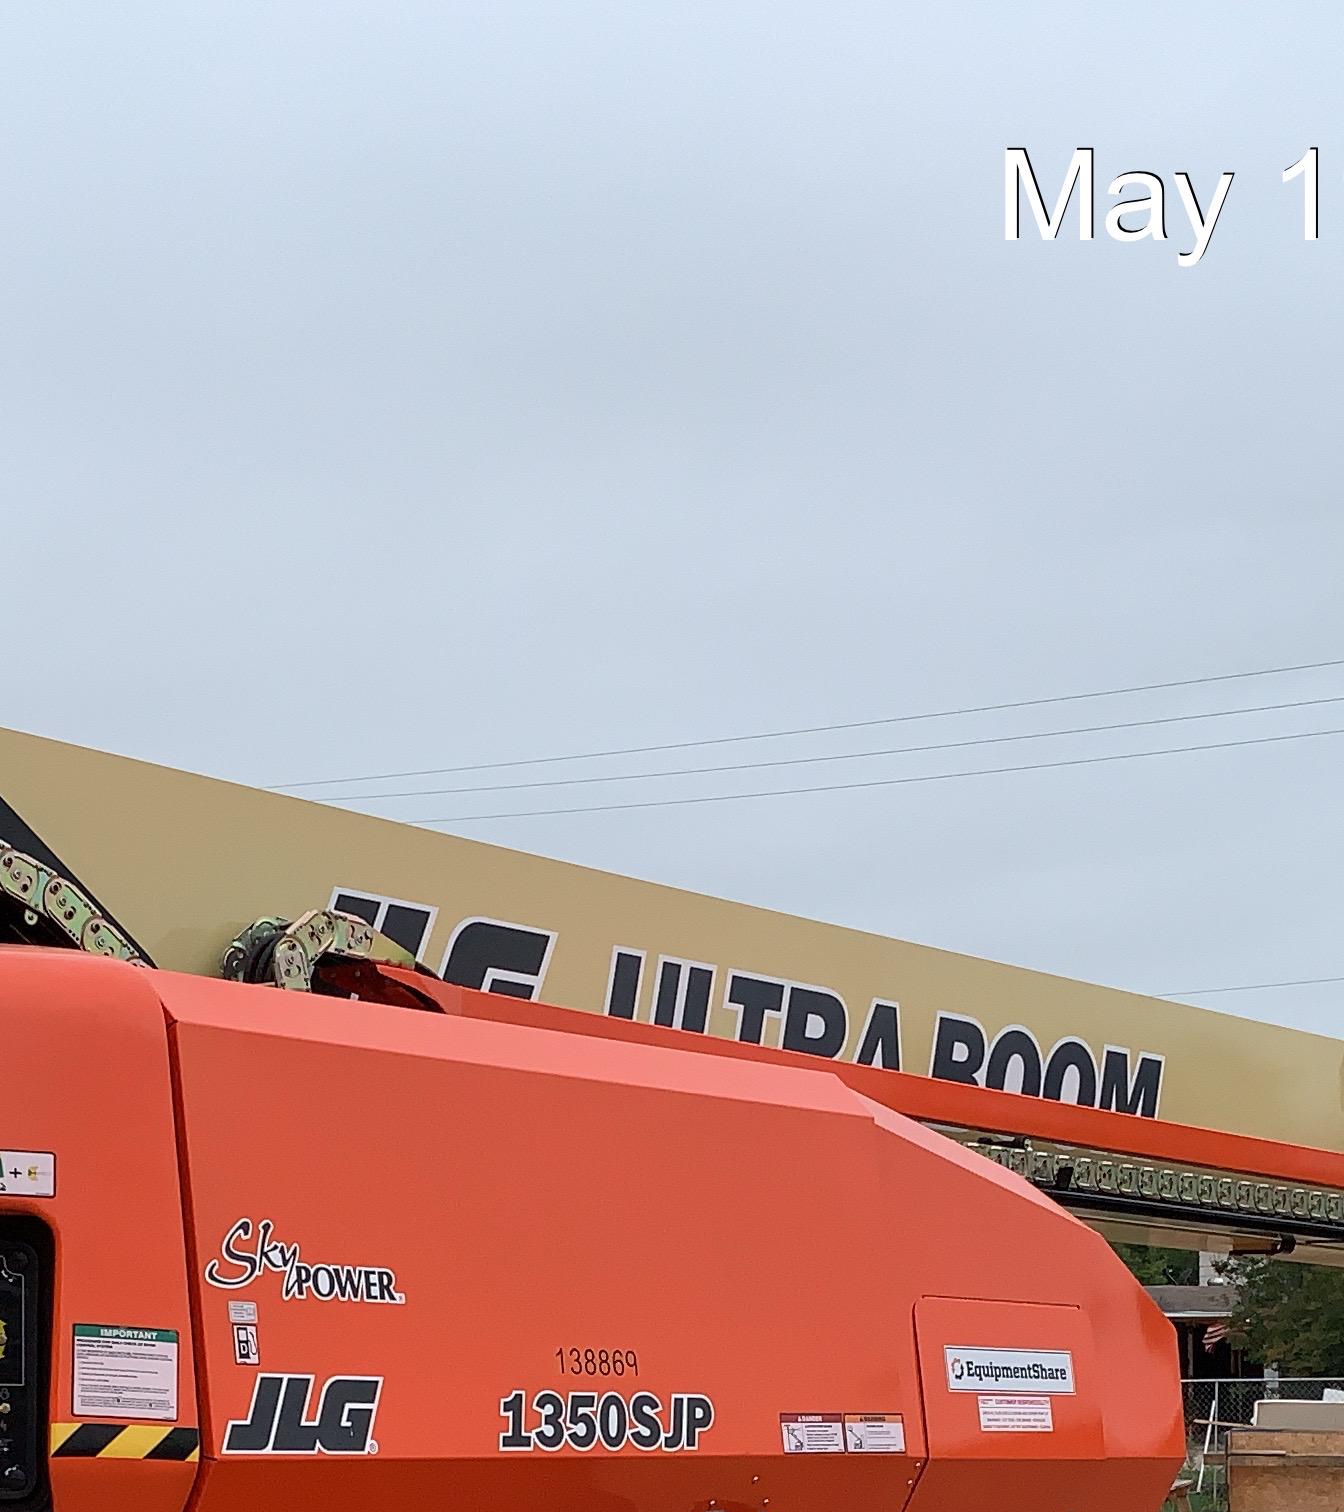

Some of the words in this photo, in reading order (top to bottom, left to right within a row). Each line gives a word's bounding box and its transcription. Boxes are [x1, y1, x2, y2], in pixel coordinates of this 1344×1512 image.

[205, 1218, 300, 1300] Sky
[293, 1262, 399, 1303] POWER
[100, 1328, 158, 1340] IMPORTANT
[555, 1347, 639, 1377] 138869
[966, 1360, 1067, 1382] EquipmentShare
[221, 1373, 384, 1455] JLG
[498, 1389, 715, 1452] 1350SJP
